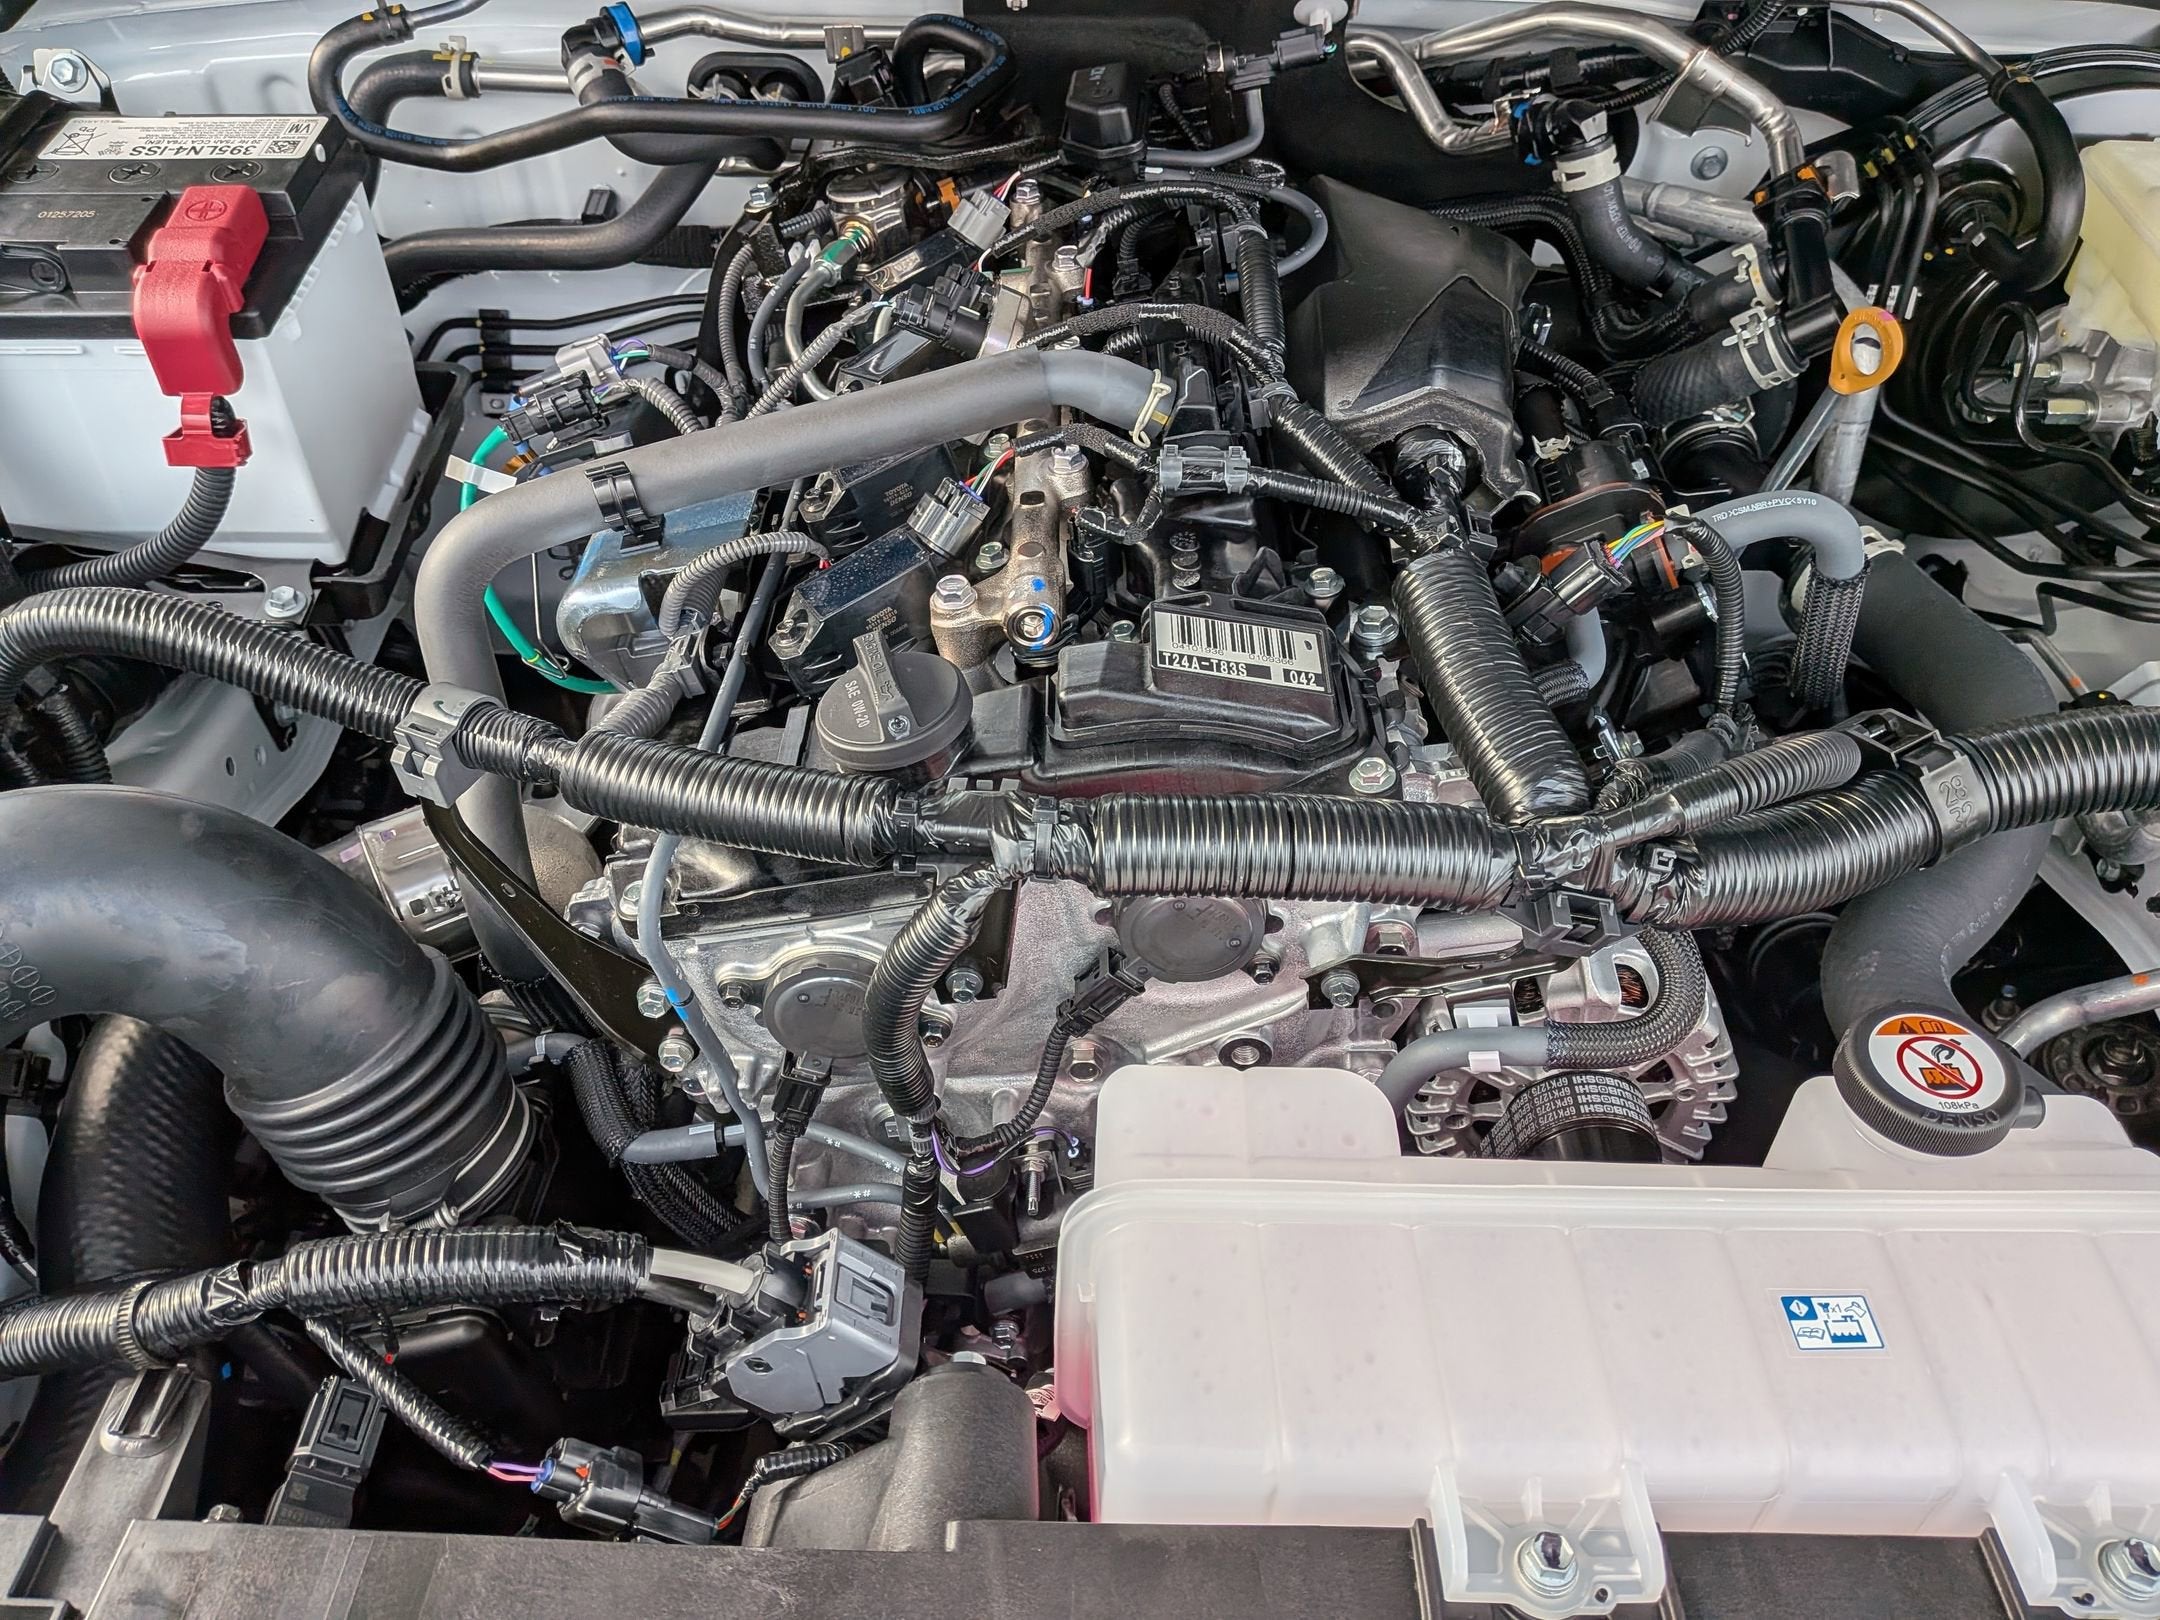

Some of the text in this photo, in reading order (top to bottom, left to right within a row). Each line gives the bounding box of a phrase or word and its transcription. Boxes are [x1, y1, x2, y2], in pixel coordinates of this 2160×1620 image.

[288, 123, 311, 134] VM
[129, 144, 258, 157] 395LN4-ISS
[37, 210, 96, 219] 01257205
[866, 606, 893, 624] TOYOTA
[871, 661, 888, 678] OIL
[1162, 652, 1317, 687] T24A-T83S 042
[844, 679, 872, 729] SAE 0W-20
[1939, 774, 1969, 809] 28
[1949, 800, 1978, 833] 32
[1531, 1076, 1568, 1097] 6PK1275
[1533, 1086, 1571, 1106] 6PK1275
[1536, 1096, 1574, 1116] 6PK1275
[1538, 1106, 1577, 1126] 6PK1275
[1938, 1100, 1980, 1112] 108kPa
[1919, 1109, 2001, 1129] DENSO
